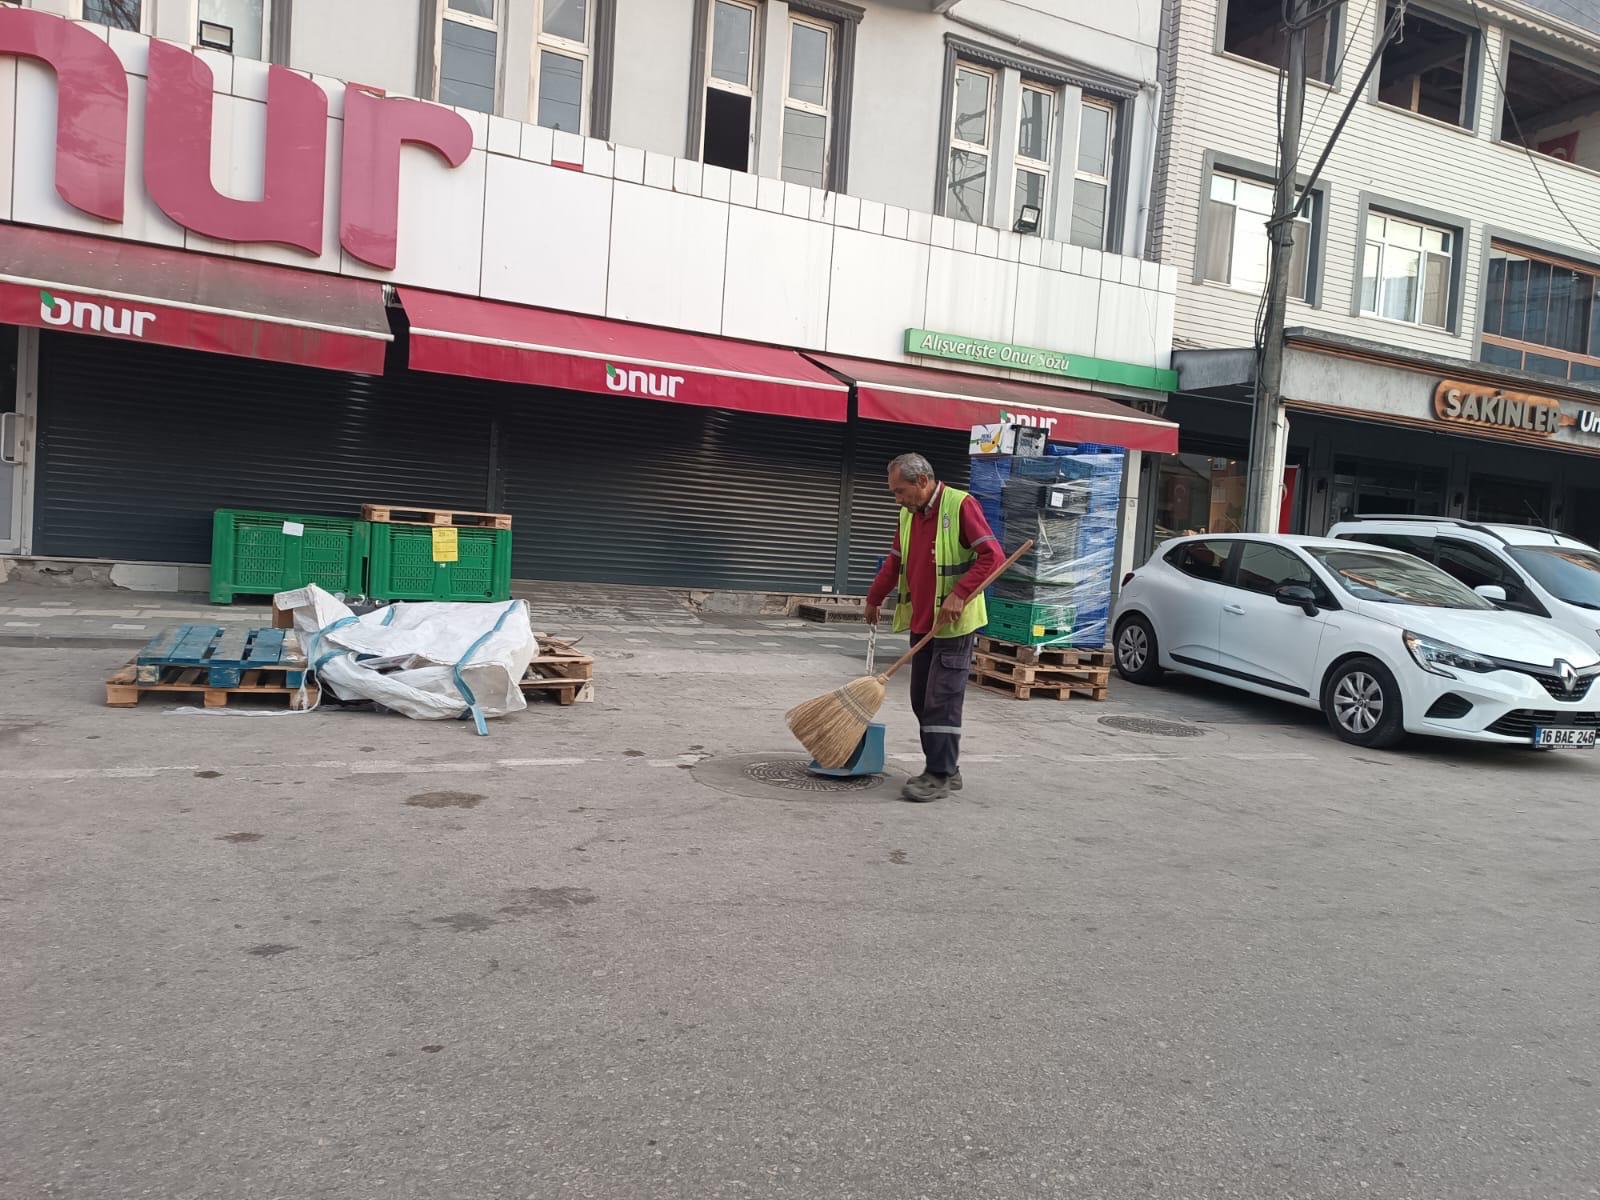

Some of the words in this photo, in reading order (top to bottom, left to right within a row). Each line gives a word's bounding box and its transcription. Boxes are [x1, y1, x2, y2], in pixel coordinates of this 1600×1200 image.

[40, 291, 157, 337] onur
[920, 334, 997, 361] Alışverişte
[1000, 346, 1036, 366] Onur
[605, 364, 685, 398] onur
[1445, 388, 1560, 434] SAKİNLER
[1542, 729, 1553, 744] 16
[1554, 730, 1576, 744] BAE
[1576, 731, 1595, 744] 246
